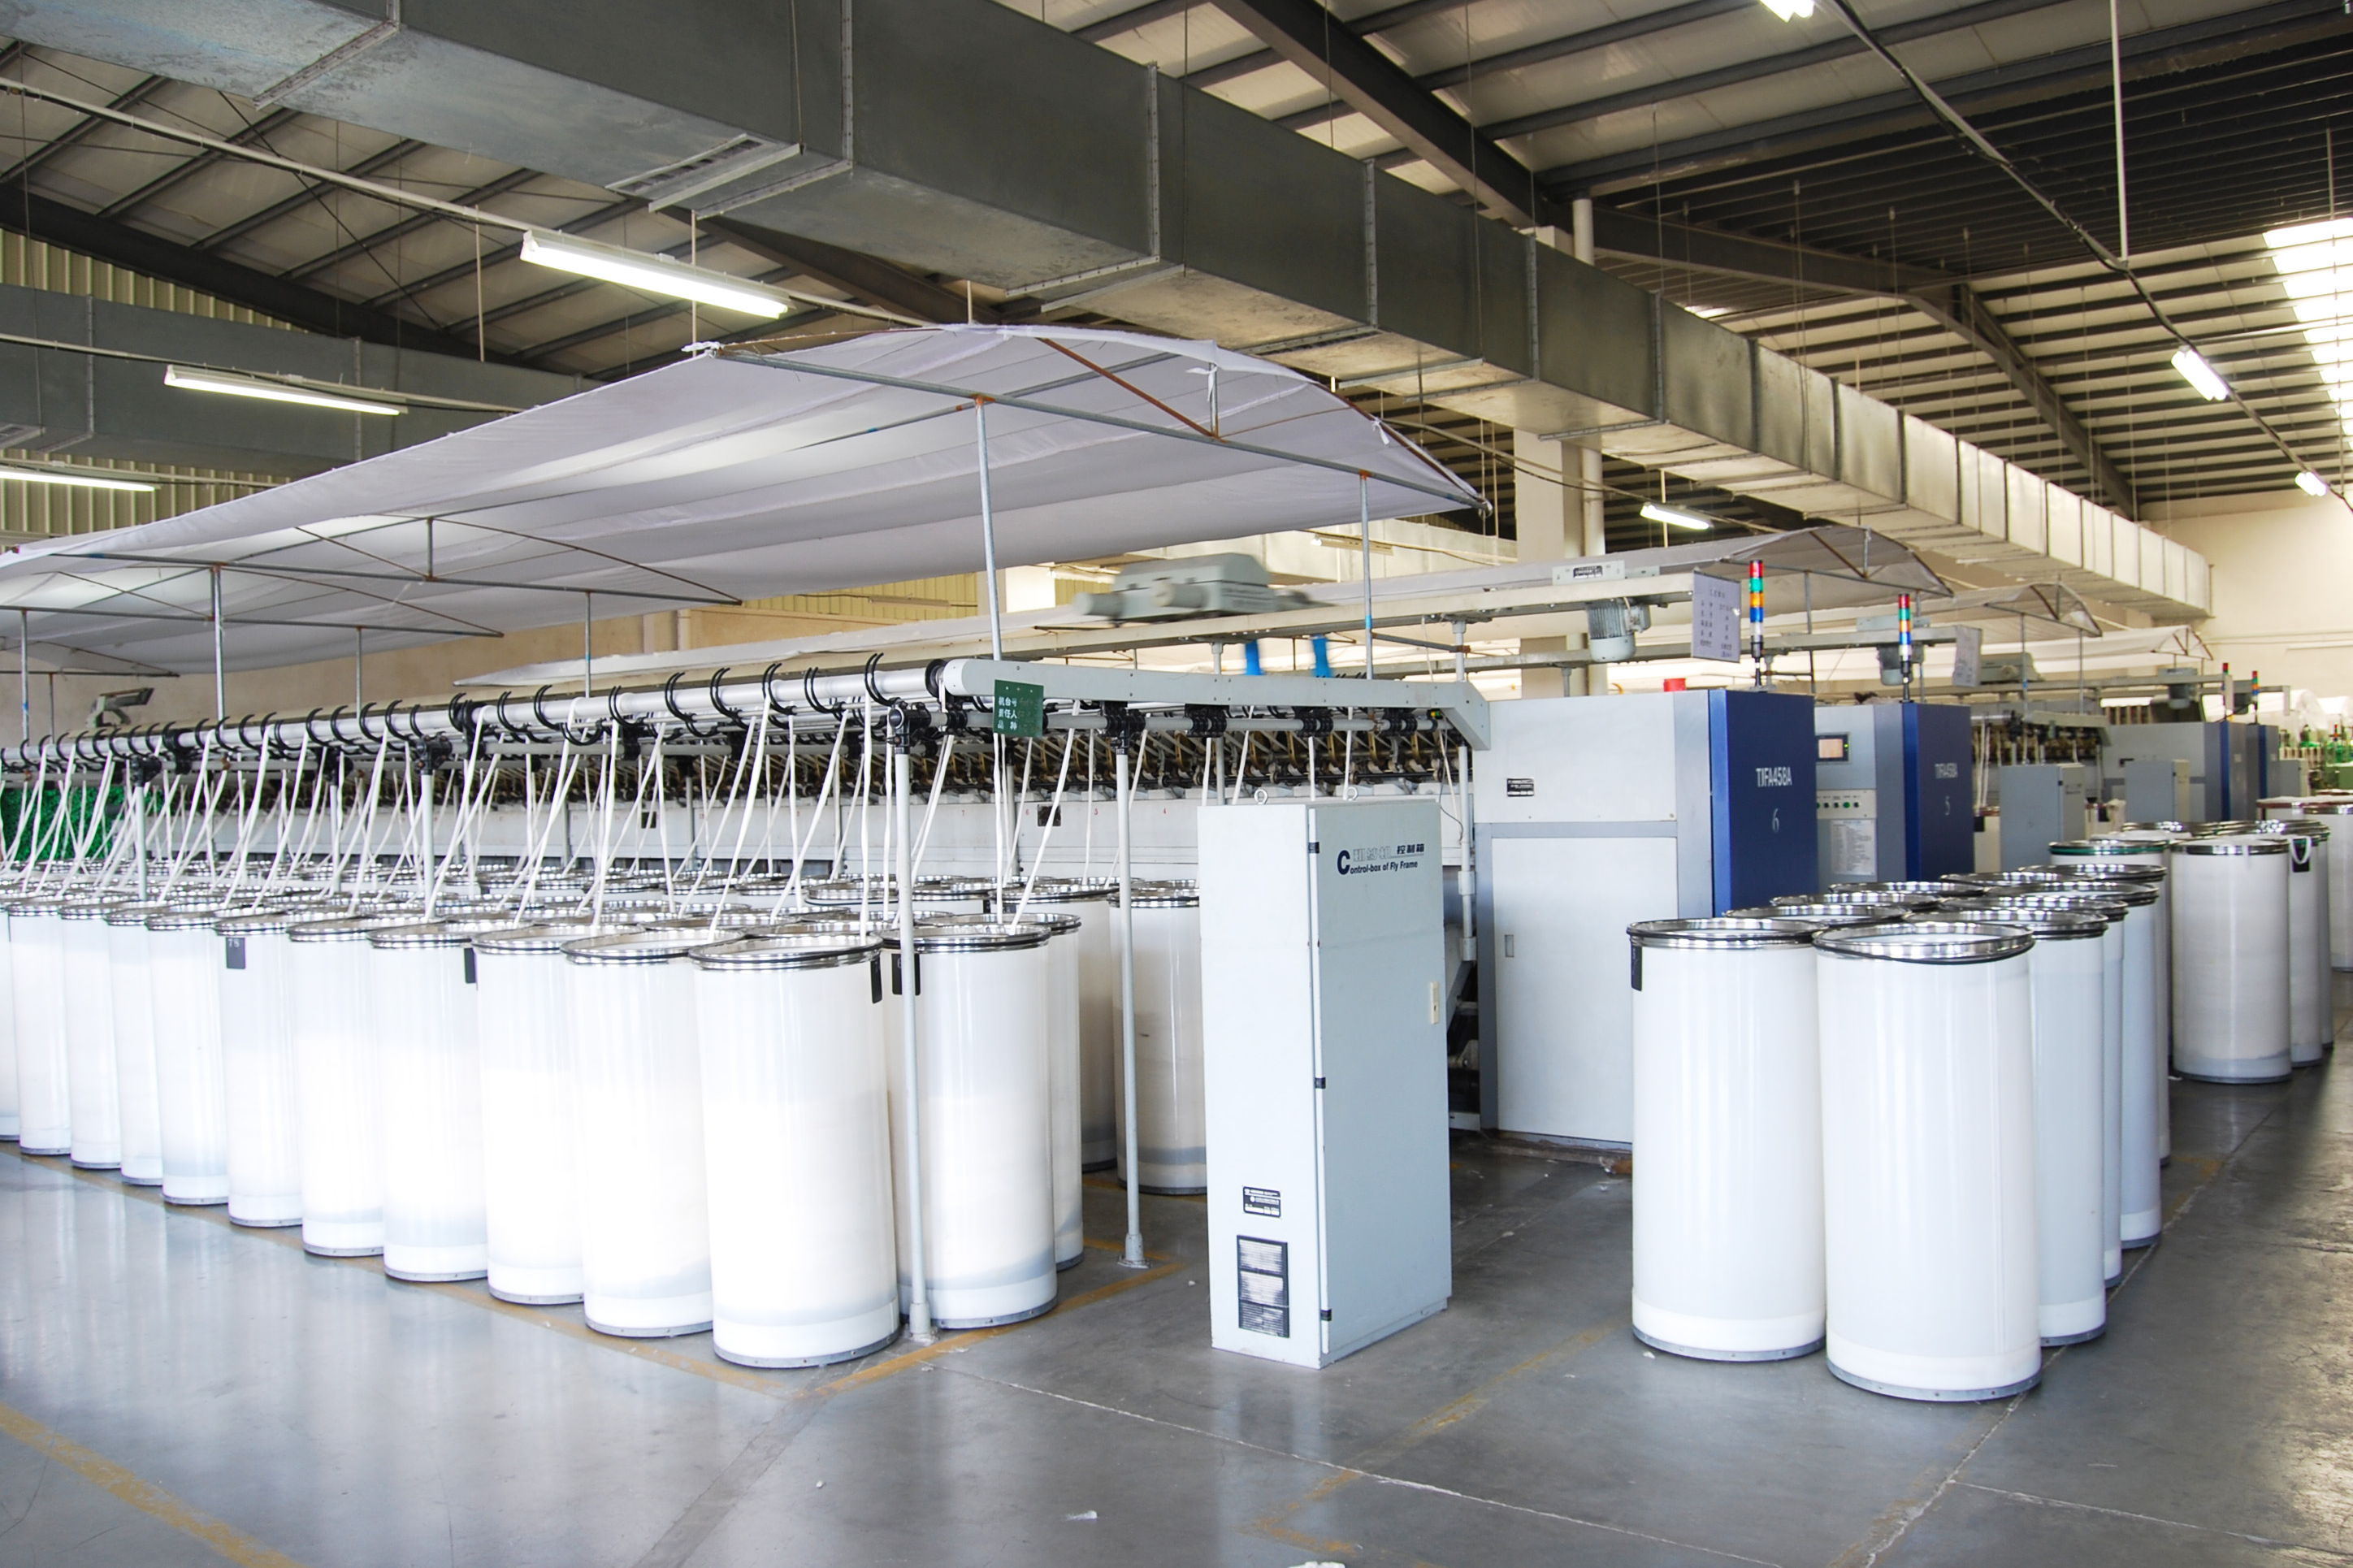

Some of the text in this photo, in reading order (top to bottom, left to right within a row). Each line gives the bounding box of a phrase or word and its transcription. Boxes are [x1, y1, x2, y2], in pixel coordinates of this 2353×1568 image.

[999, 708, 1017, 719] 责任人
[1772, 808, 1779, 834] 6
[1382, 862, 1389, 871] of
[1390, 861, 1398, 872] Fly
[1400, 860, 1418, 869] Frame
